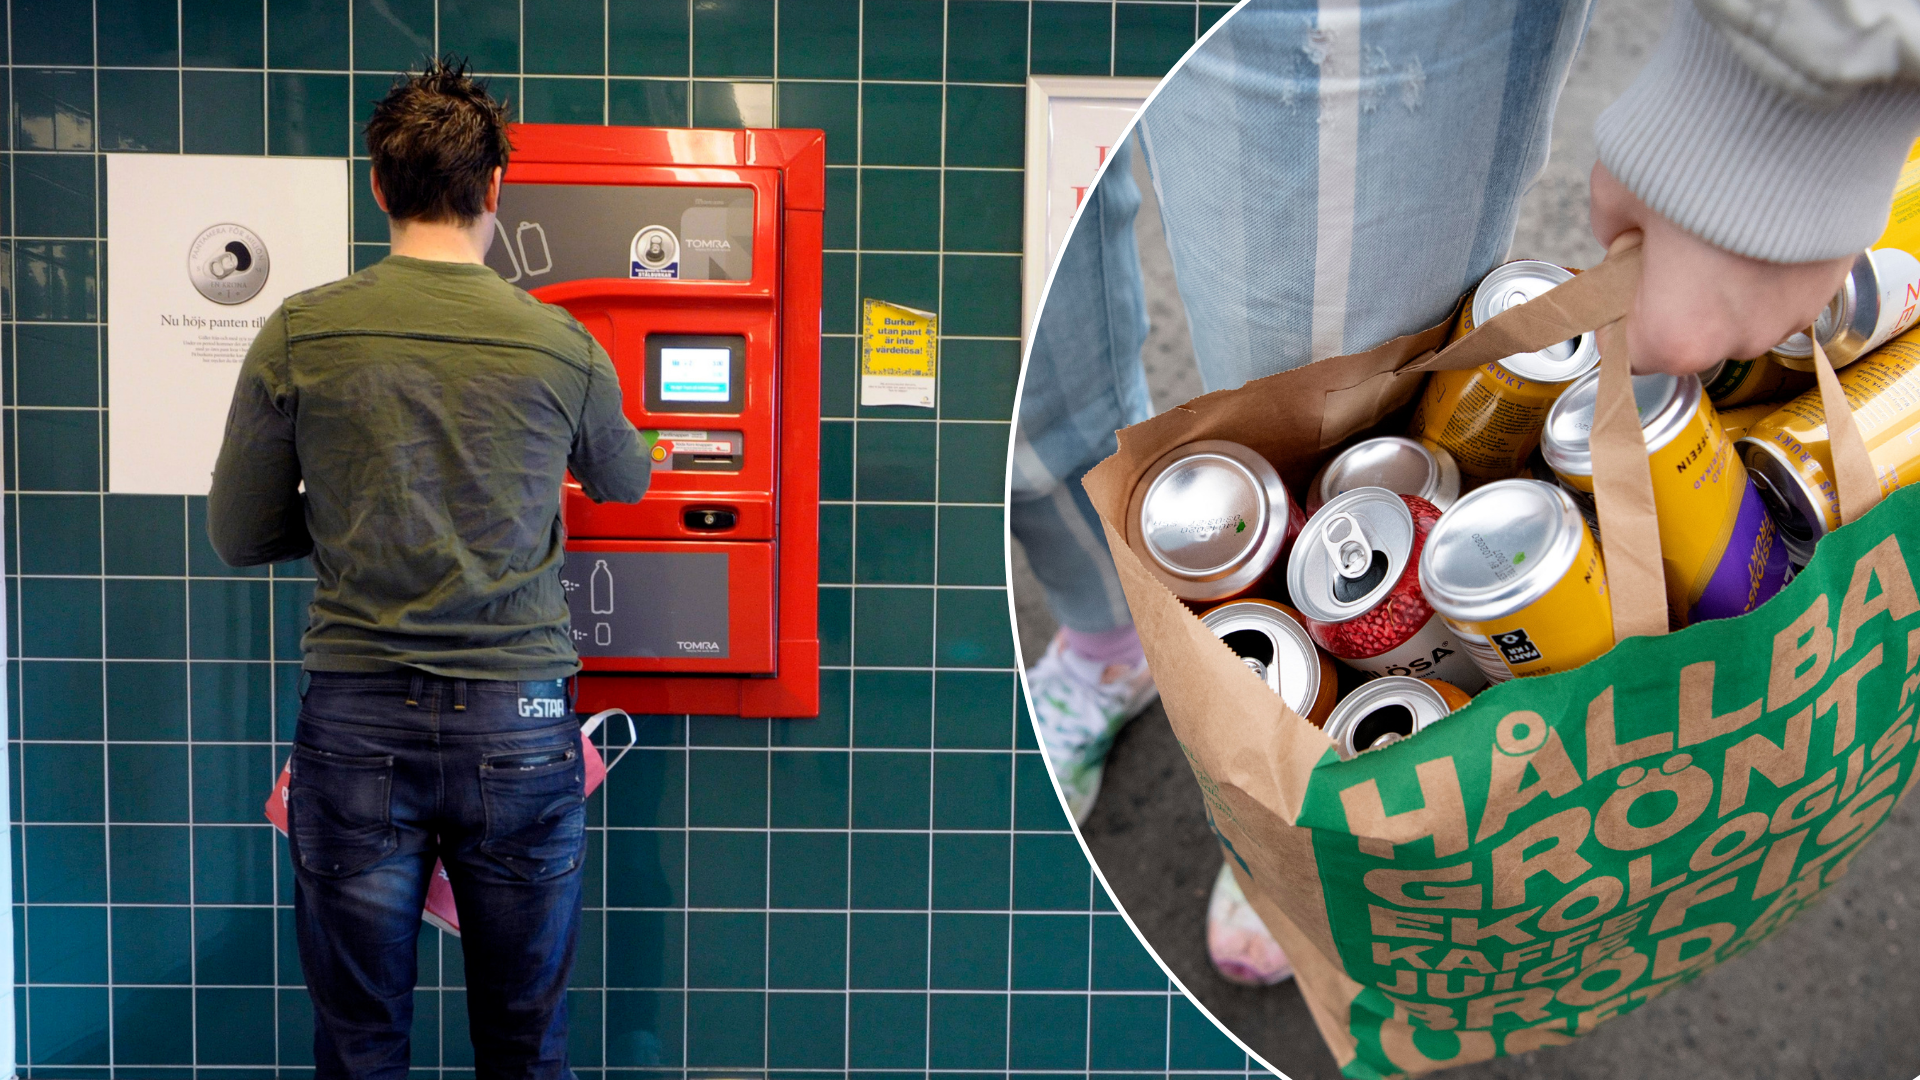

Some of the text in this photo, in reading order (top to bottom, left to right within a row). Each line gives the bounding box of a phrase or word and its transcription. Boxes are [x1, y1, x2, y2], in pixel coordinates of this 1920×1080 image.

[685, 239, 731, 249] TOMRA
[160, 314, 267, 330] Nu höjs panten till
[884, 318, 916, 326] Burkar
[884, 337, 915, 345] är inte
[901, 328, 922, 337] pant
[875, 346, 923, 355] värdelösa!
[1486, 362, 1526, 391] RUKT
[1774, 430, 1822, 472] FRUKT
[1743, 519, 1776, 612] ASSIONS-
[572, 629, 588, 641] 1:-
[676, 641, 720, 650] TOMRA
[1508, 649, 1540, 662] PANT
[518, 697, 565, 718] G-STAR
[1364, 641, 1884, 911] GRÖNT
[1367, 702, 1916, 947] EKOLOGIS
[1371, 902, 1650, 973] KAFFE
[1376, 935, 1631, 1000] JUICE
[1381, 921, 1738, 1032] BRÖD
